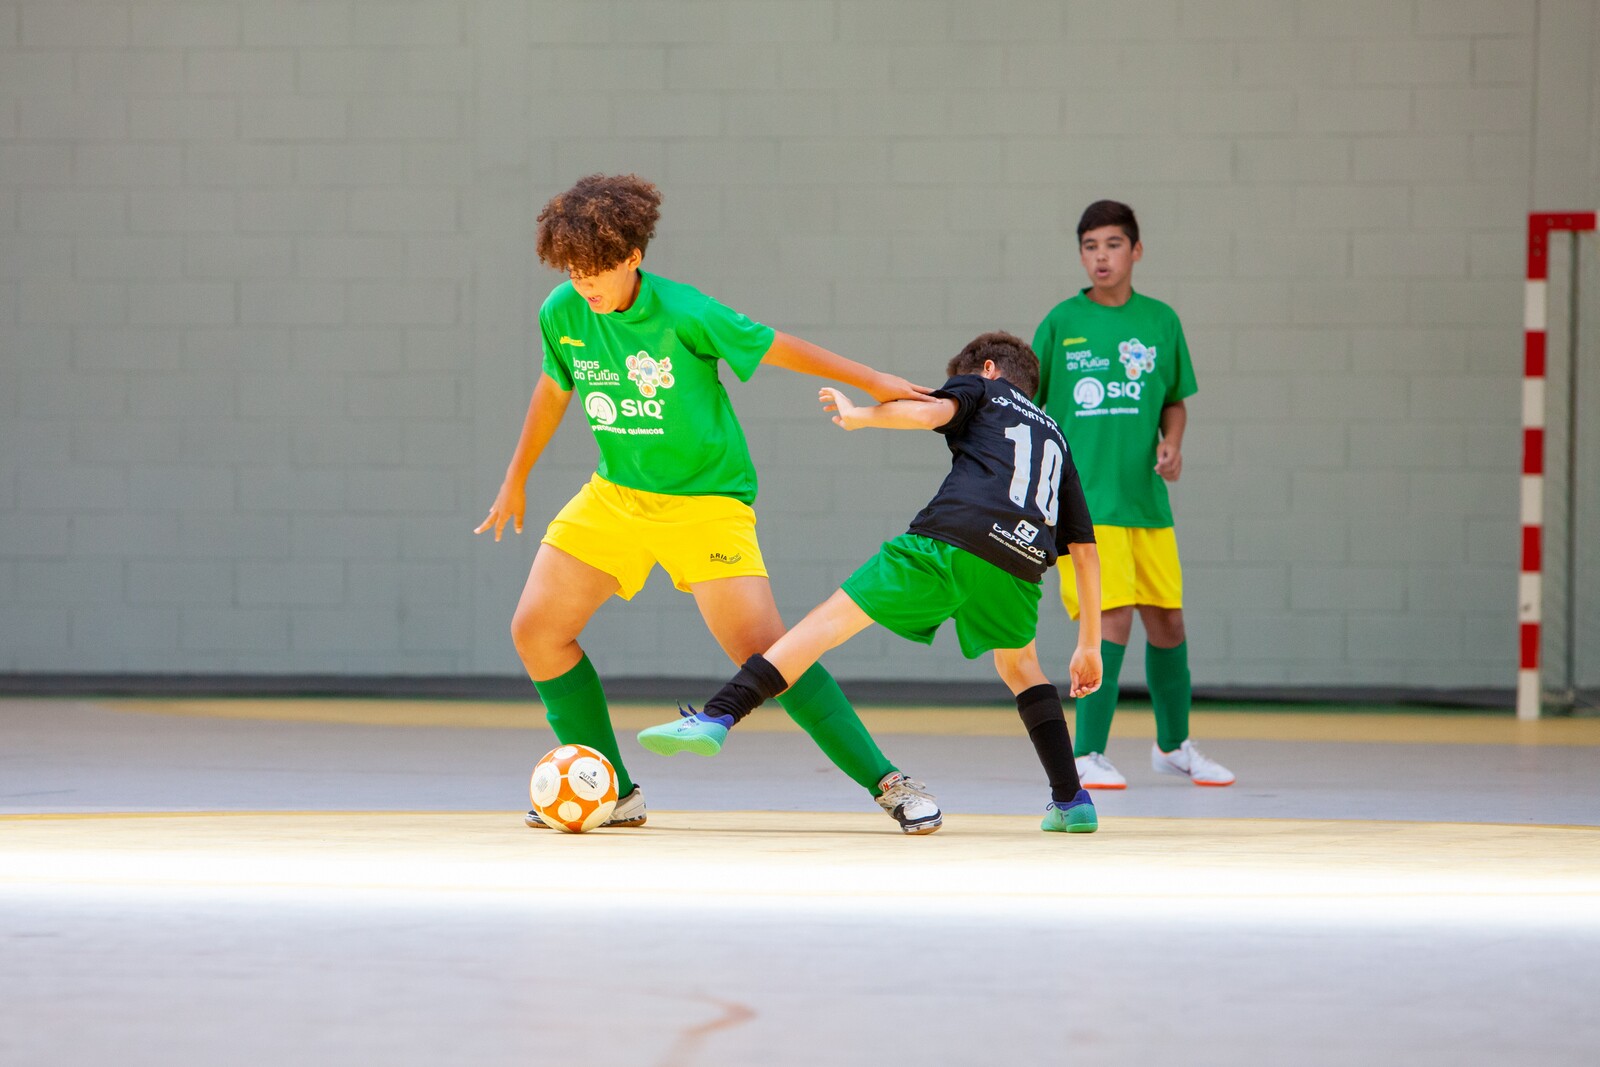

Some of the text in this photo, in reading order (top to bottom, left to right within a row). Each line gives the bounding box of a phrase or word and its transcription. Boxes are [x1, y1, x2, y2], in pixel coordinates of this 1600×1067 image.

[620, 398, 663, 420] SIQ
[1005, 422, 1063, 527] 10
[710, 552, 728, 561] ARIA
